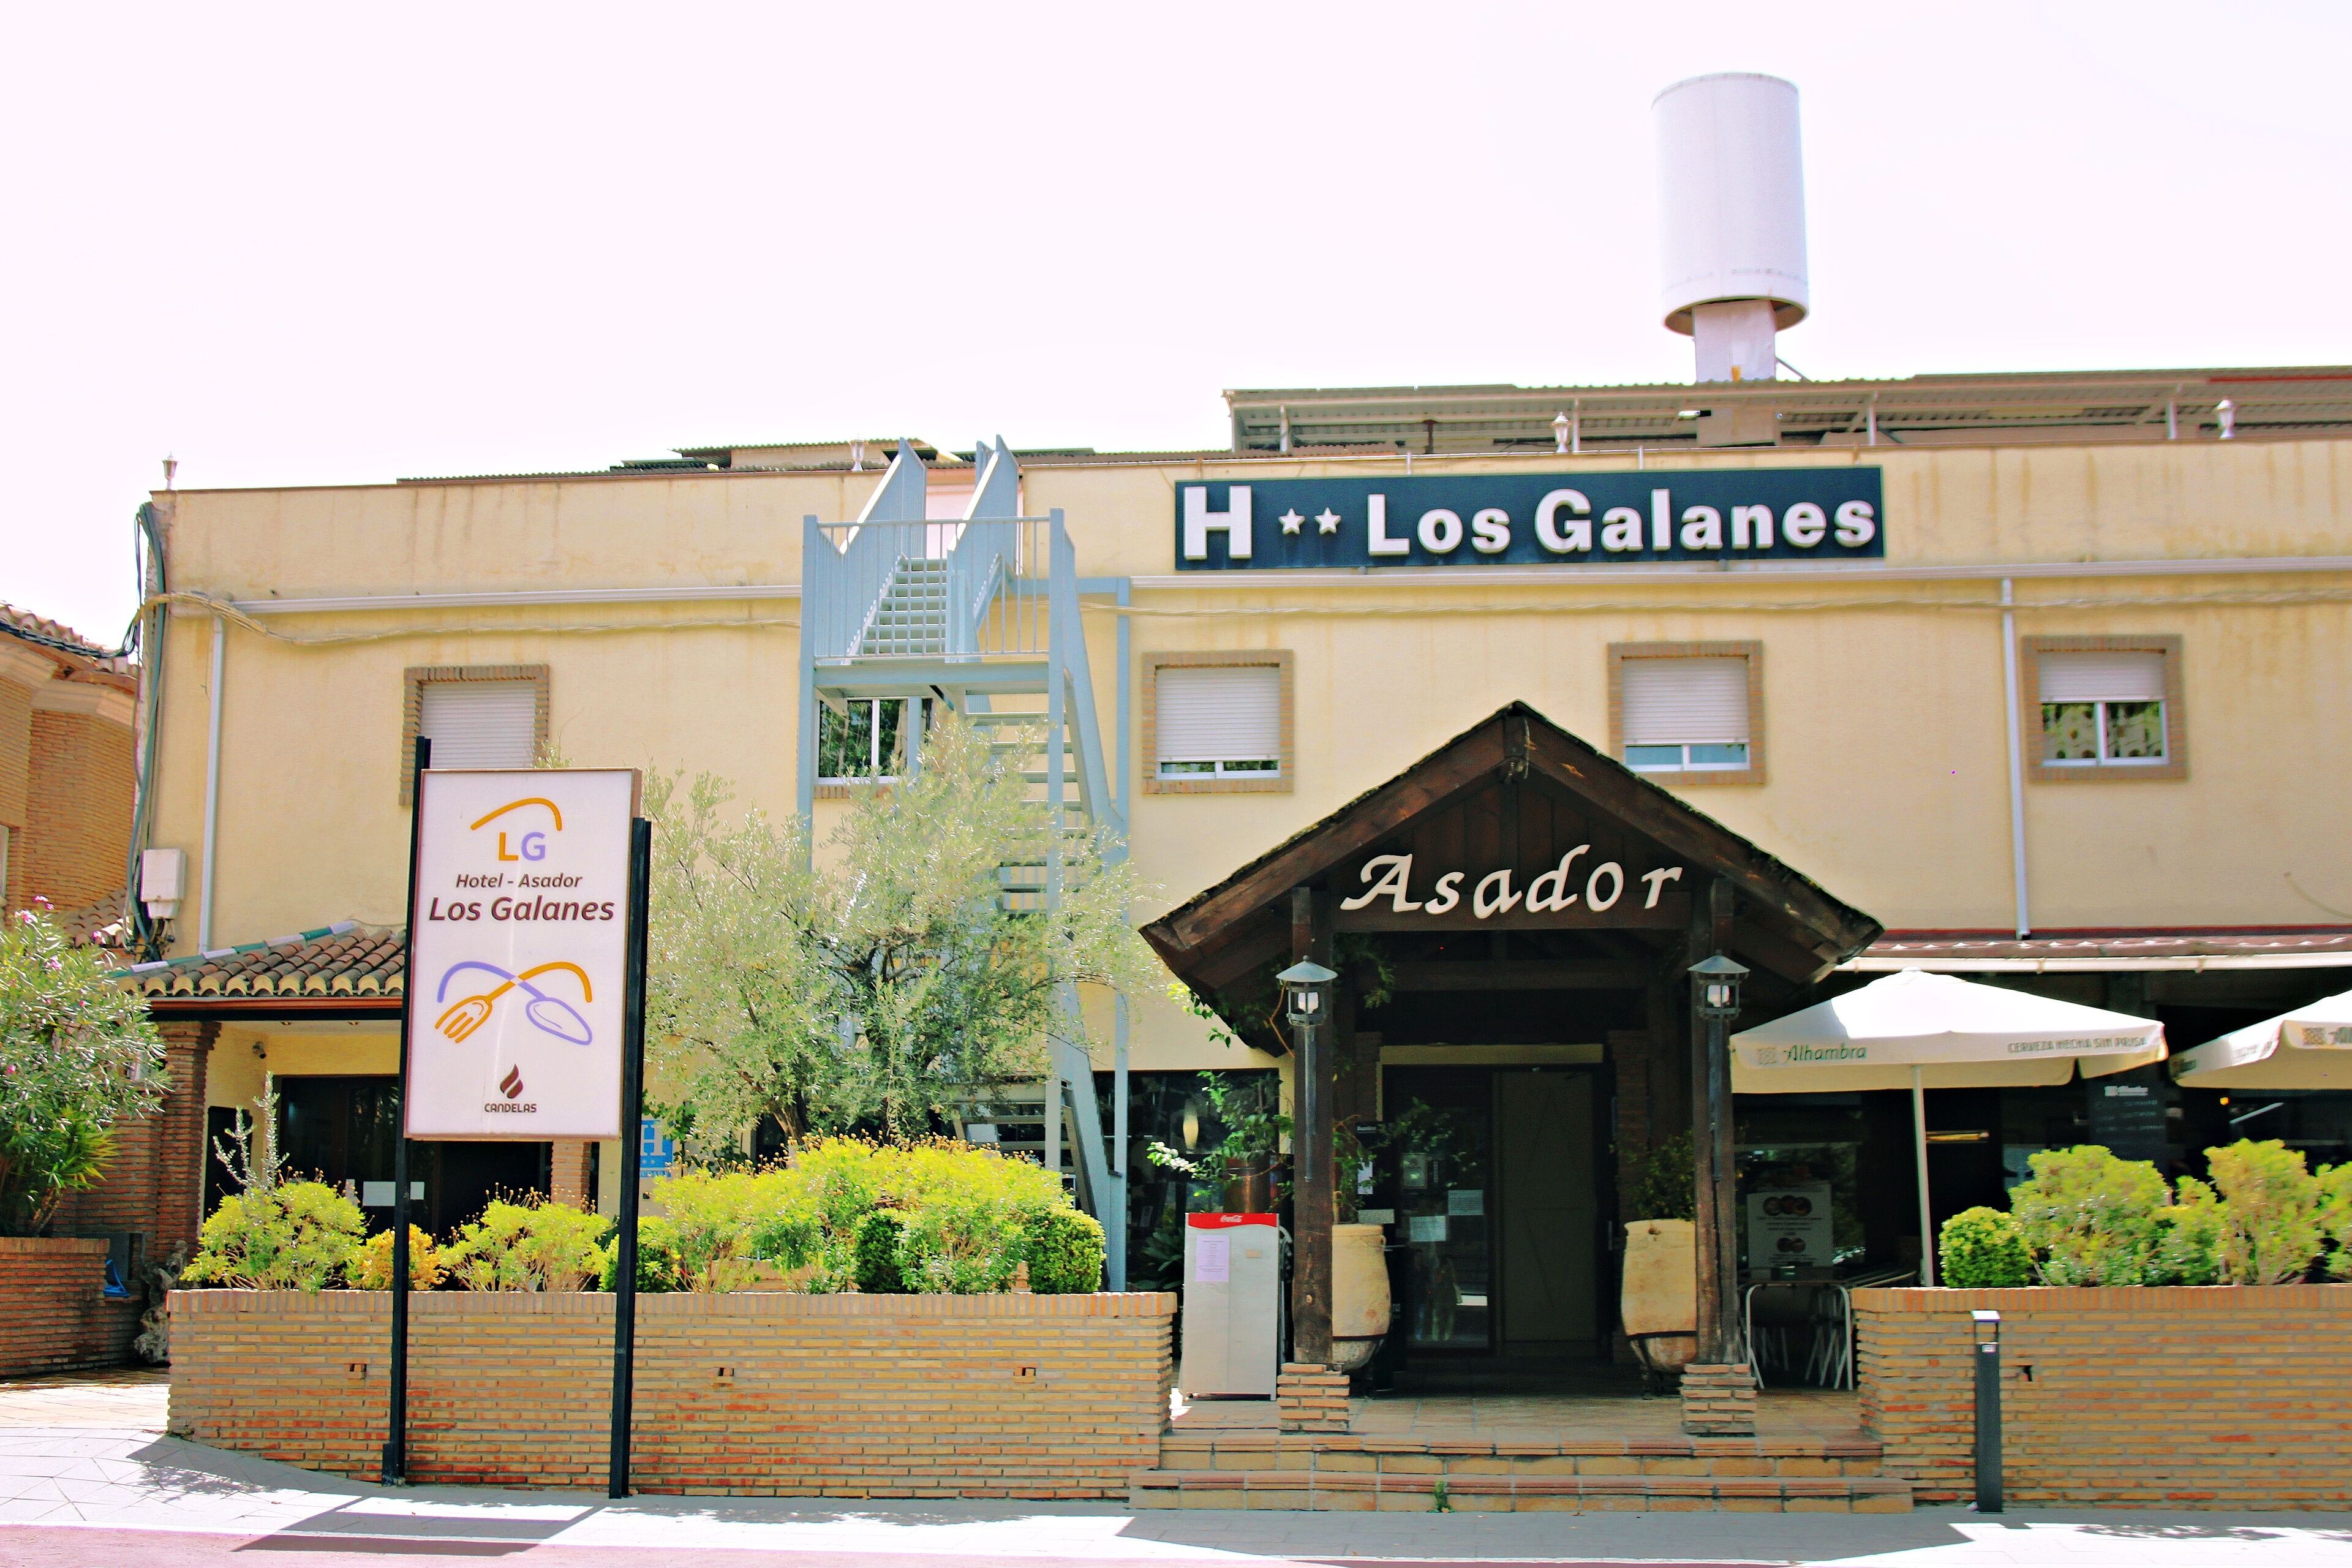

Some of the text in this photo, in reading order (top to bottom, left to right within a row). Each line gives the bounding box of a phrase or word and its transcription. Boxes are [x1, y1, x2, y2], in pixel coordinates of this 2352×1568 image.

[1183, 485, 1875, 560] H Los Galanes
[498, 831, 546, 861] LG
[455, 872, 504, 888] Hotel
[518, 872, 584, 888] Asador
[1340, 843, 1683, 919] Asador
[429, 894, 616, 921] Los Galanes
[1784, 1043, 1867, 1063] Alhambra
[484, 1102, 537, 1113] CANDELAS
